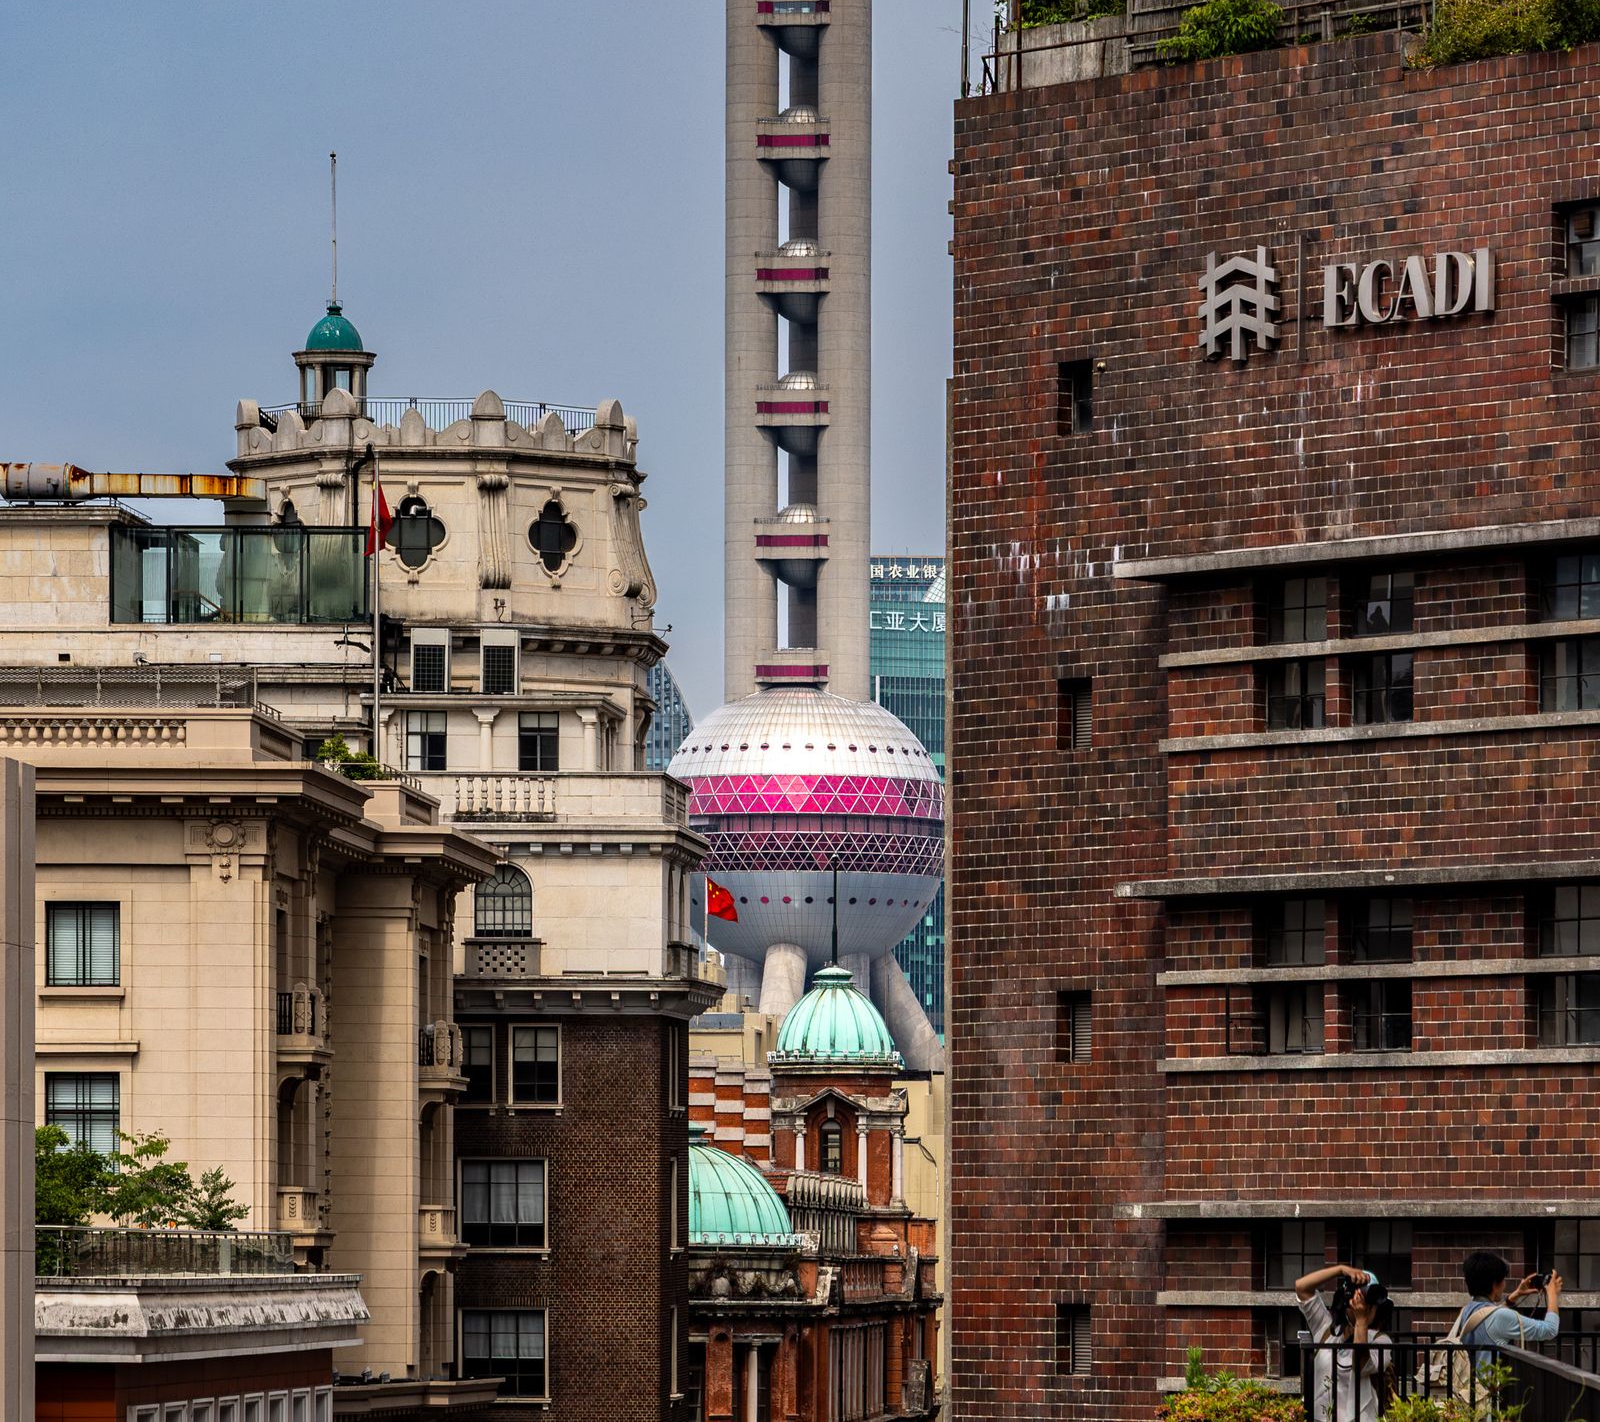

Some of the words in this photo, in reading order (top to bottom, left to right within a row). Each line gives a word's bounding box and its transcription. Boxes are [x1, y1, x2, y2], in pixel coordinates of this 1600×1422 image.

[1323, 247, 1496, 327] ECADI
[870, 564, 946, 579] 国农业银
